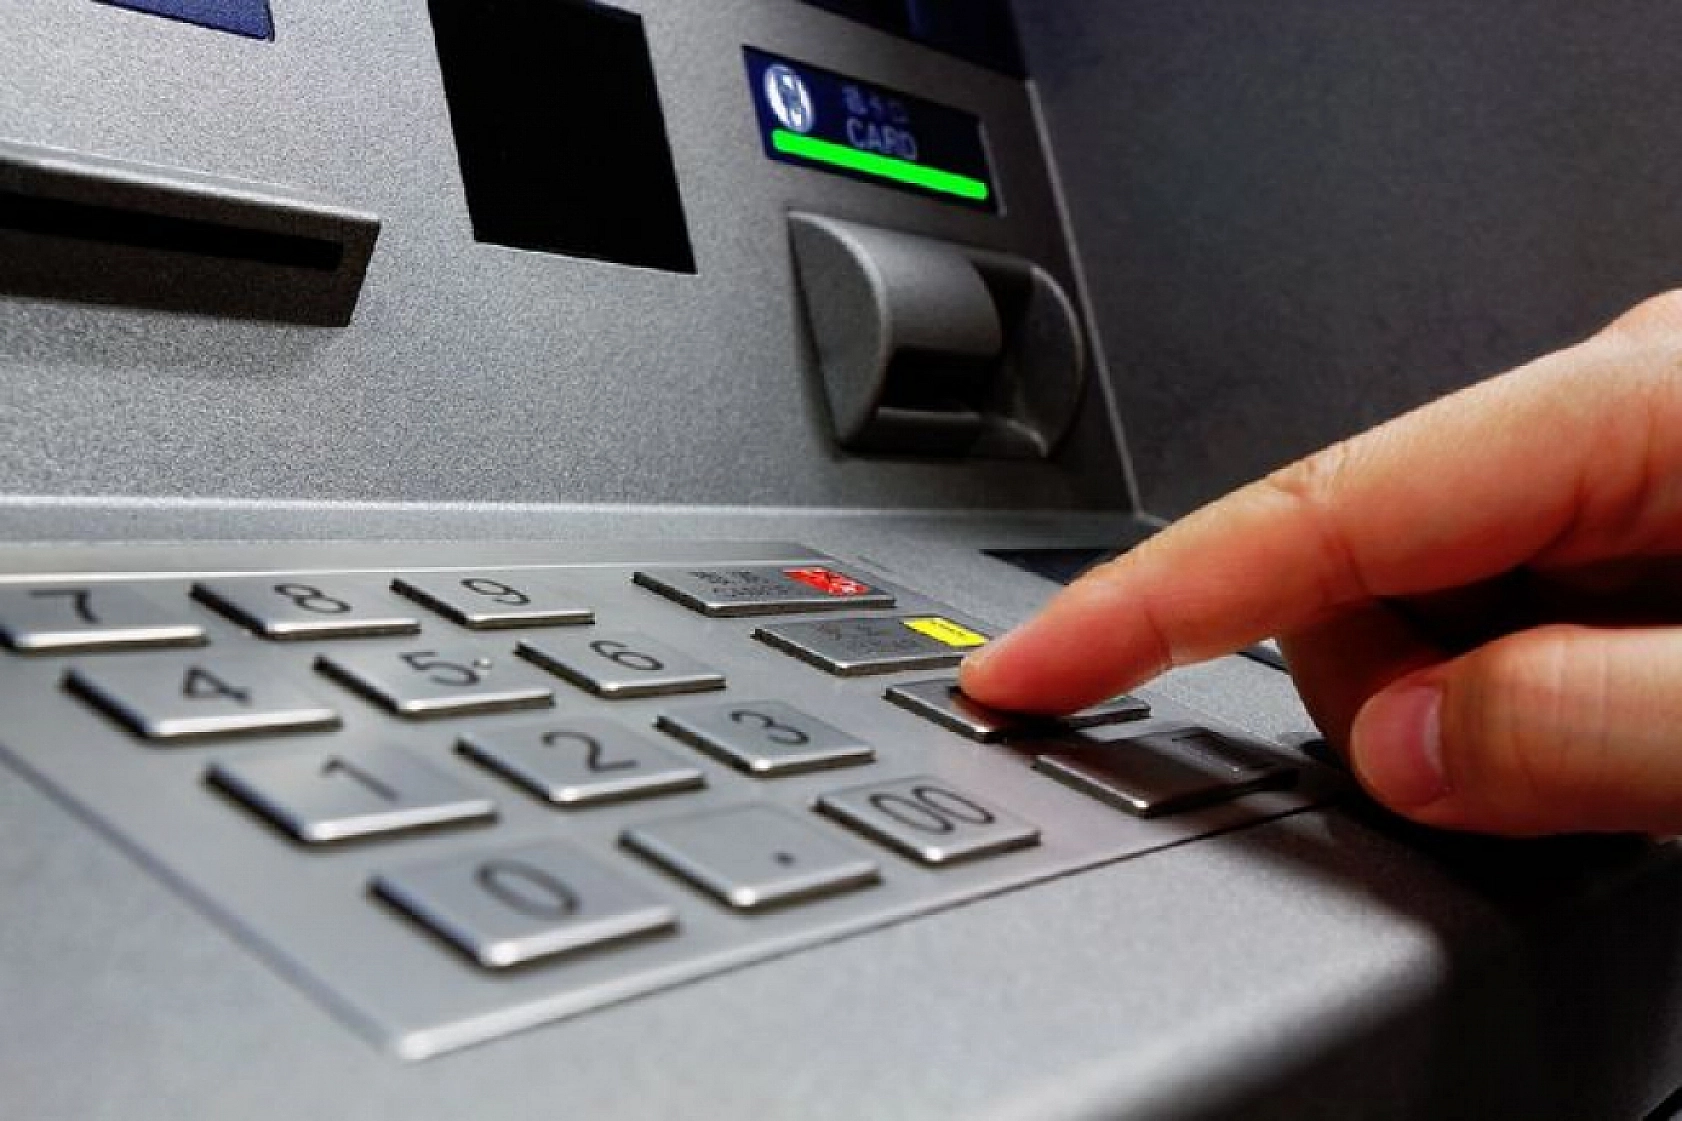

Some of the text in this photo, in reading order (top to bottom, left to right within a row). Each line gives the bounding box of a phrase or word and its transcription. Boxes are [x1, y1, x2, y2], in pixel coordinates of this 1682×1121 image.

[846, 116, 918, 160] CARD
[29, 589, 99, 624] 7
[274, 583, 351, 613] 8
[460, 578, 531, 605] 9
[402, 651, 480, 686] 5
[590, 640, 664, 670] 6
[183, 666, 250, 702] 4
[729, 710, 809, 744] 3
[542, 731, 637, 772] 2
[322, 756, 399, 801] 1
[869, 785, 995, 834] 00
[474, 859, 580, 920] 0
